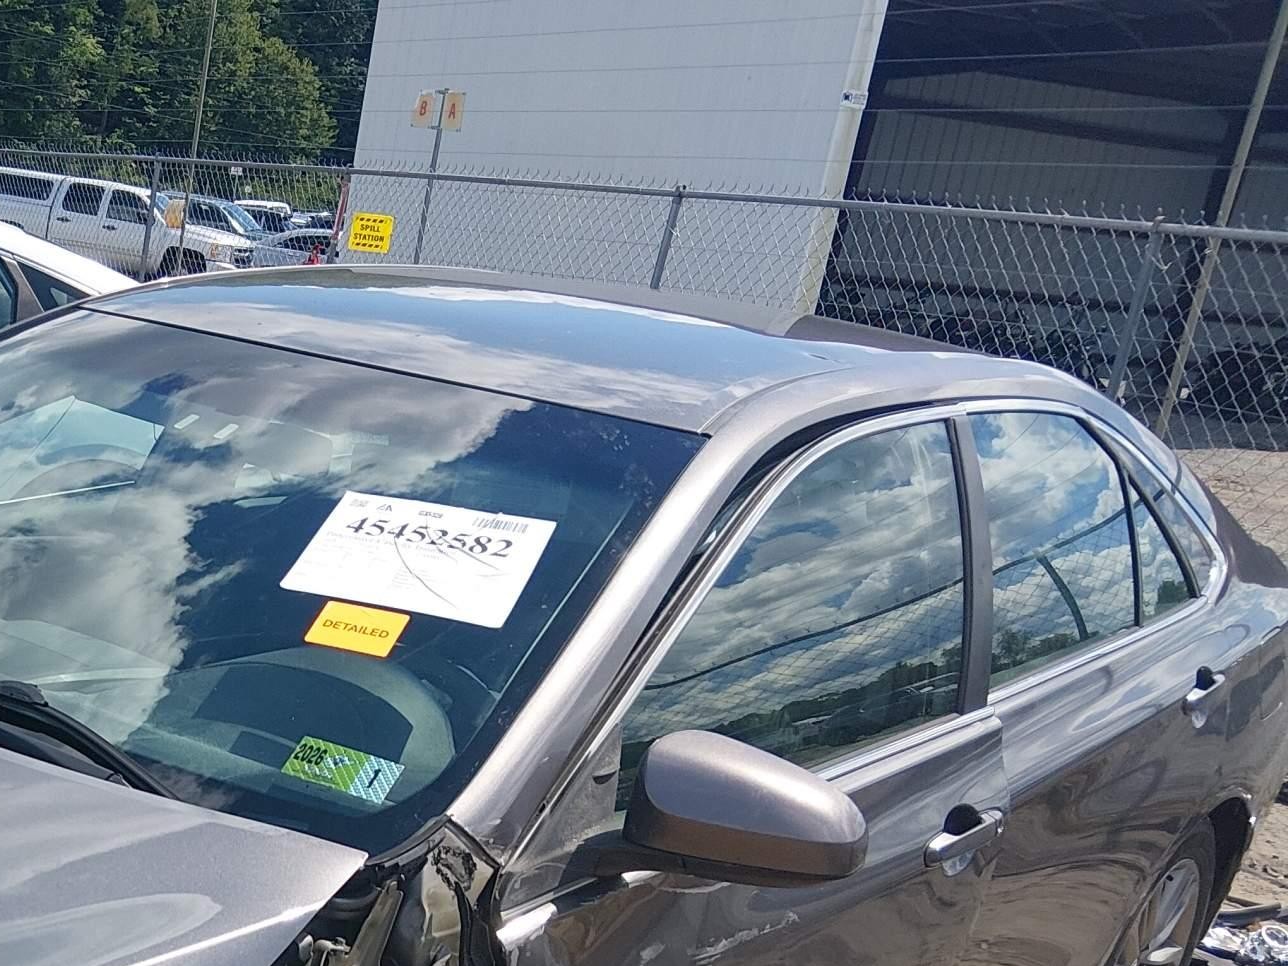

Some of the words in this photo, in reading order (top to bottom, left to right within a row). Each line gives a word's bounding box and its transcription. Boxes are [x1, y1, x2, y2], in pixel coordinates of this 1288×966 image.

[419, 100, 428, 116] B
[448, 103, 456, 119] A
[359, 223, 381, 233] SPILL
[353, 232, 385, 243] STATION
[346, 516, 513, 558] 45452582
[322, 619, 390, 639] DETAILED
[293, 743, 328, 766] 2026
[367, 768, 382, 788] 1
